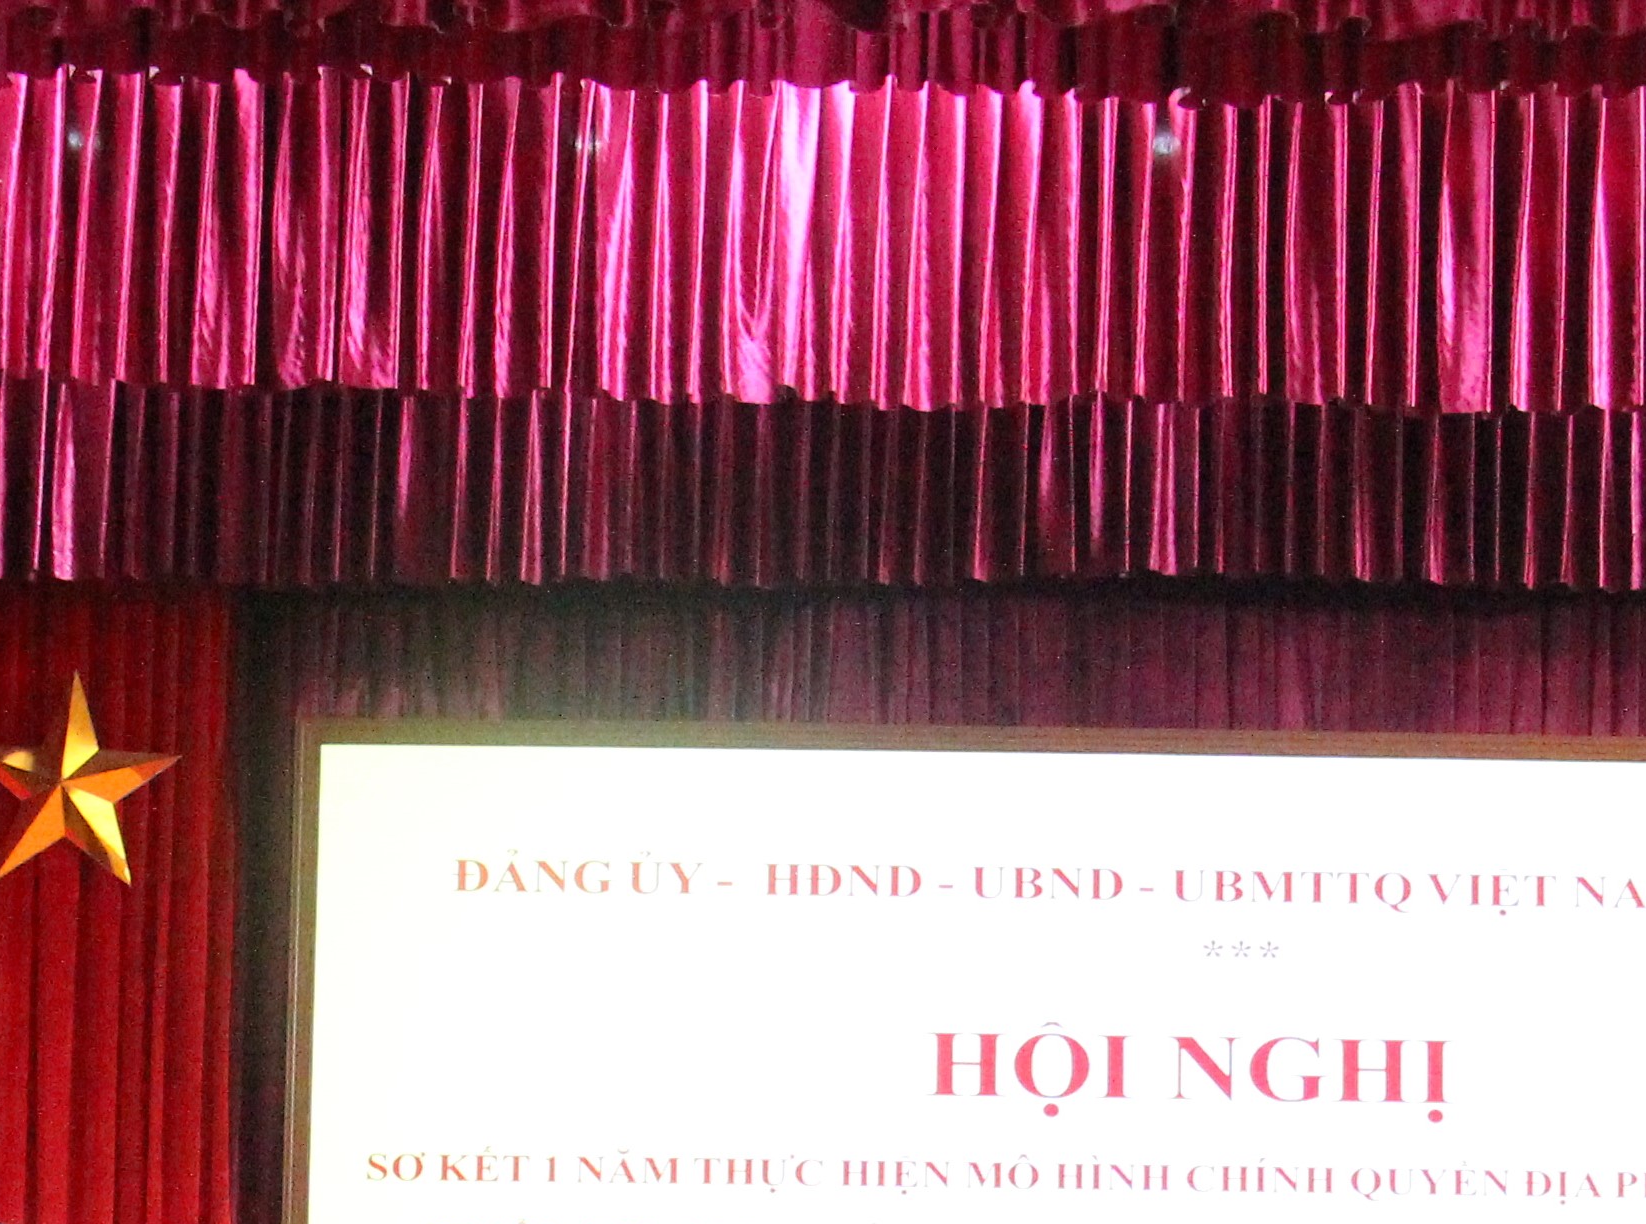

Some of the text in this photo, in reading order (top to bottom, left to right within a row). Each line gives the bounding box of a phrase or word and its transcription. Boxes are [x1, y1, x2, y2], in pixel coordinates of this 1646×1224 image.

[453, 849, 611, 893] ĐẢNG
[630, 851, 702, 895] ỦY
[766, 863, 922, 897] HĐND
[974, 866, 1124, 901] UBND
[1175, 869, 1412, 913] UBMTTQ
[1428, 869, 1558, 917] VIỆT
[928, 1021, 1451, 1124] HỘI NGHỊ
[366, 1151, 426, 1182] SƠ
[546, 1155, 556, 1183] 1
[578, 1150, 679, 1184] NĂM
[695, 1155, 823, 1193] THỰC
[842, 1156, 950, 1195] HIỆN
[968, 1154, 1040, 1189] MÔ
[1057, 1155, 1169, 1191] HÌNH
[1186, 1157, 1333, 1194] CHÍNH
[1525, 1170, 1602, 1206] ĐỊA
